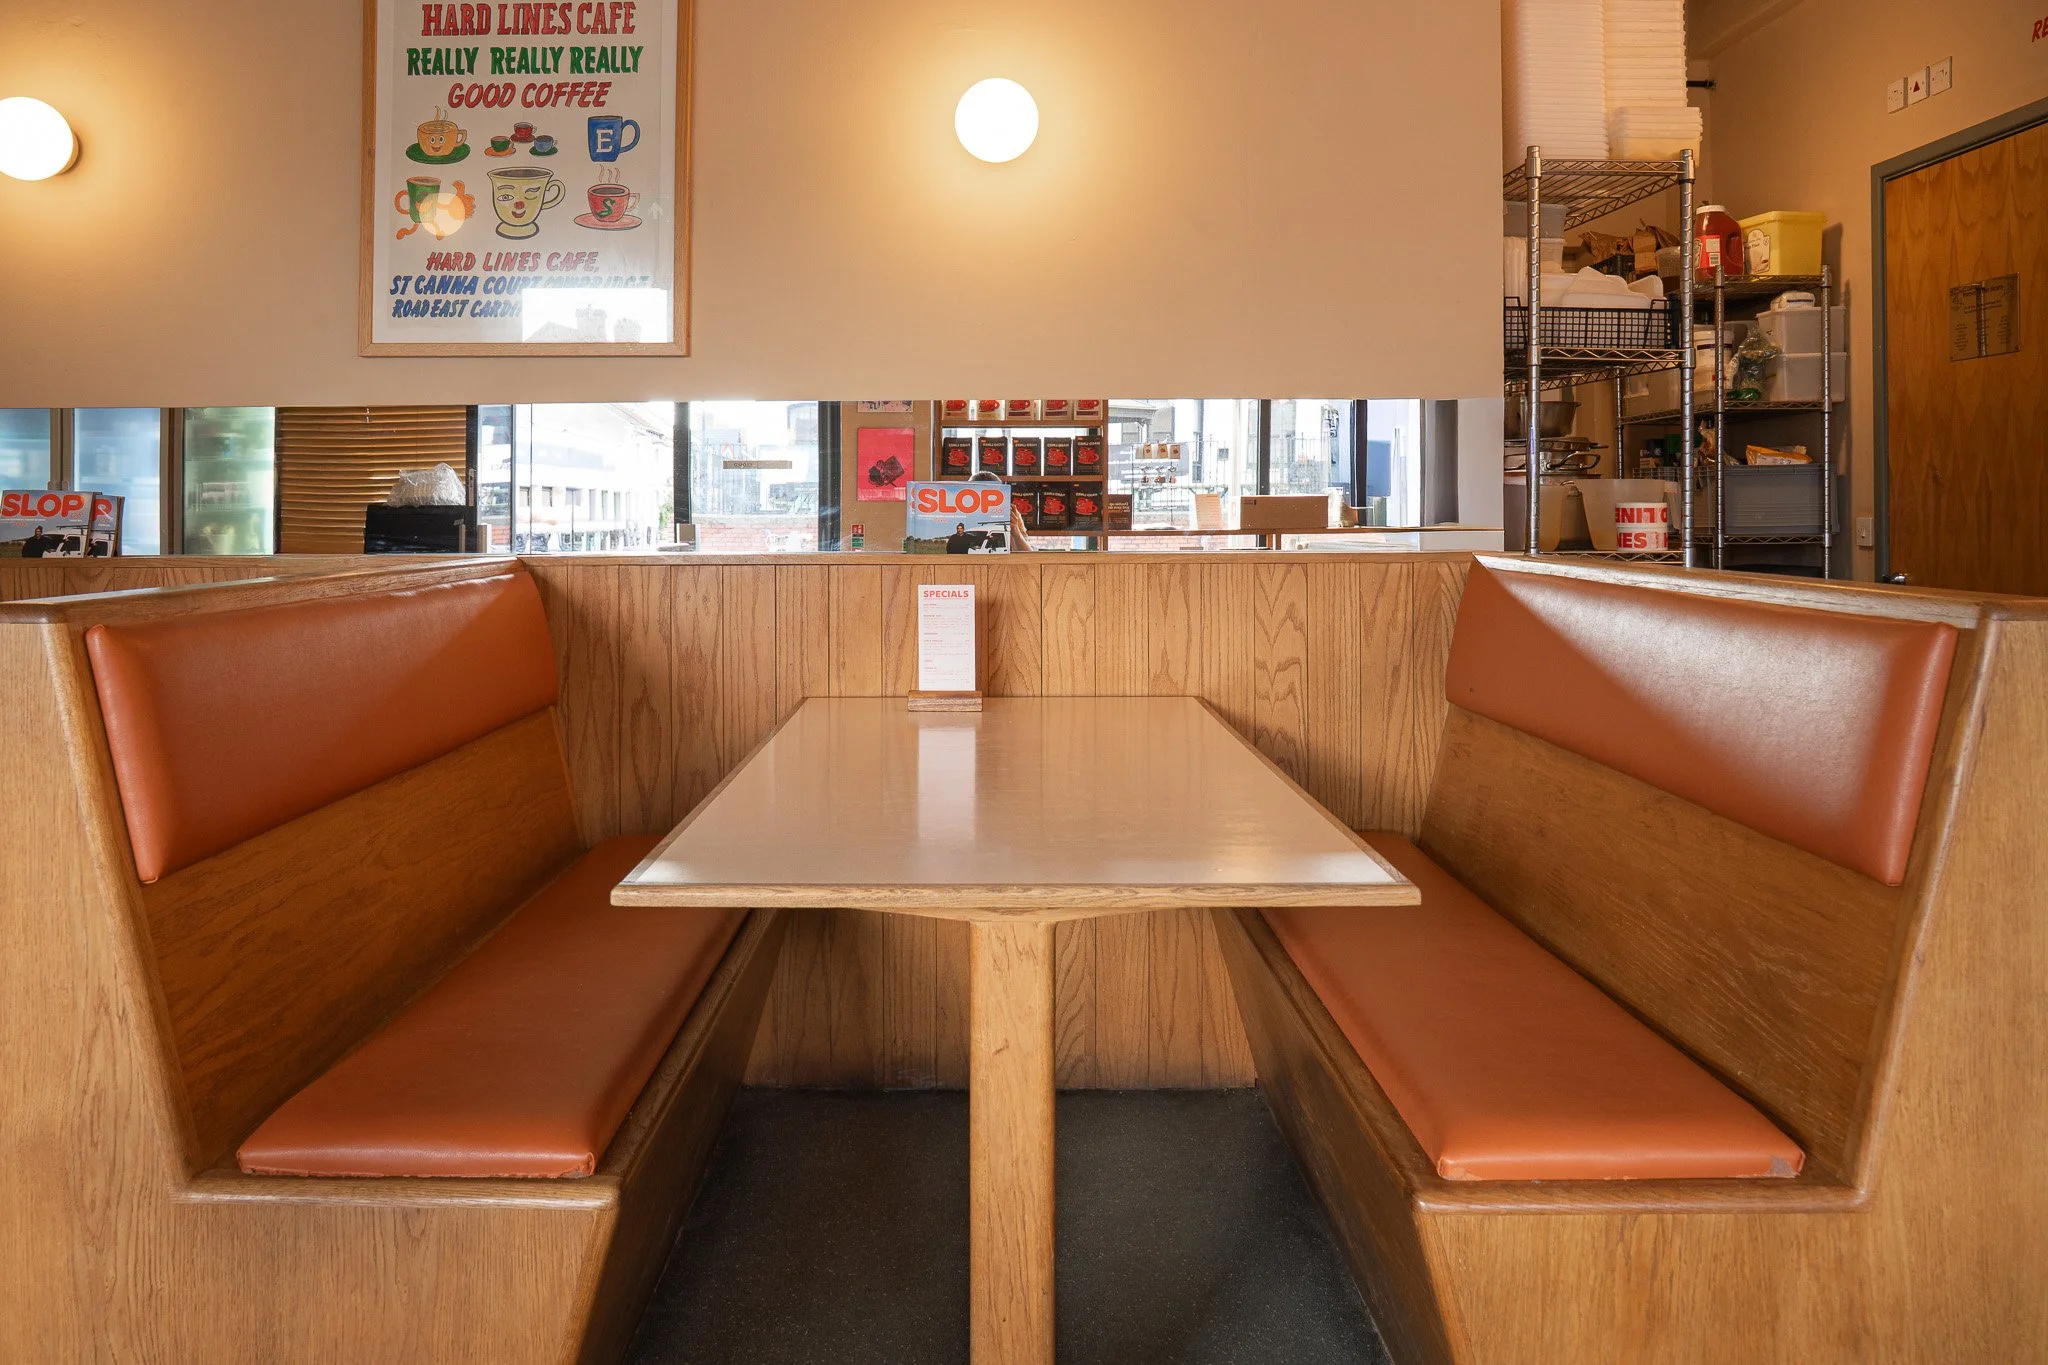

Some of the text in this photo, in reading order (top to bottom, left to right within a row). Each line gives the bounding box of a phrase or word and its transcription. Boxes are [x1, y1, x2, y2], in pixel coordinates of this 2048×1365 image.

[421, 1, 637, 36] HARD LINES CAFE
[406, 45, 644, 76] REALLY REALLY REALLY
[447, 81, 612, 108] GOOD COFFEE
[596, 129, 614, 153] E
[595, 198, 616, 218] S
[425, 251, 600, 274] HARD LINES CAFE,
[389, 275, 413, 296] ST
[414, 275, 480, 296] CANNA
[391, 299, 431, 318] ROAD
[430, 299, 470, 318] EAST
[1, 493, 85, 518] SLOP
[917, 488, 1005, 514] SLOP
[923, 590, 969, 598] SPECIALS
